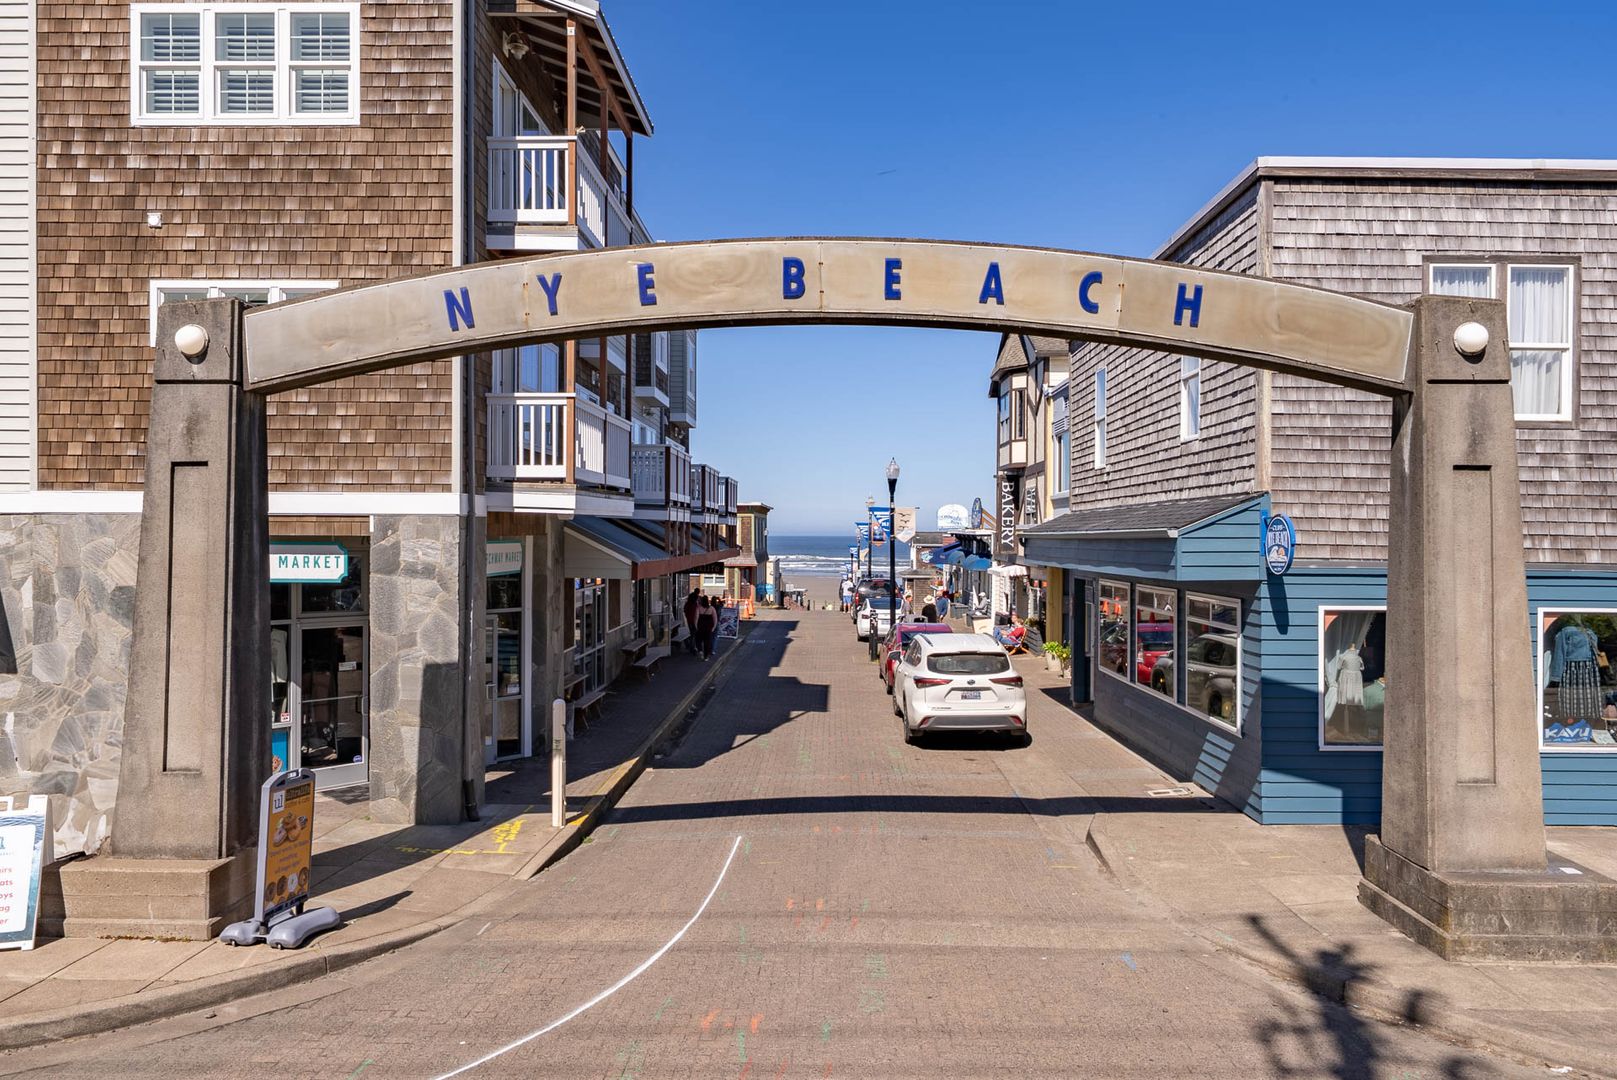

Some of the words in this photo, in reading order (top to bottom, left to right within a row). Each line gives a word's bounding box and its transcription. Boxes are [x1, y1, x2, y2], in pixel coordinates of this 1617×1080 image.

[443, 263, 658, 332] NYE
[782, 257, 1203, 328] BEACH
[1001, 481, 1014, 547] BAKERY
[278, 555, 341, 569] MARKET
[1544, 727, 1590, 738] KAVU
